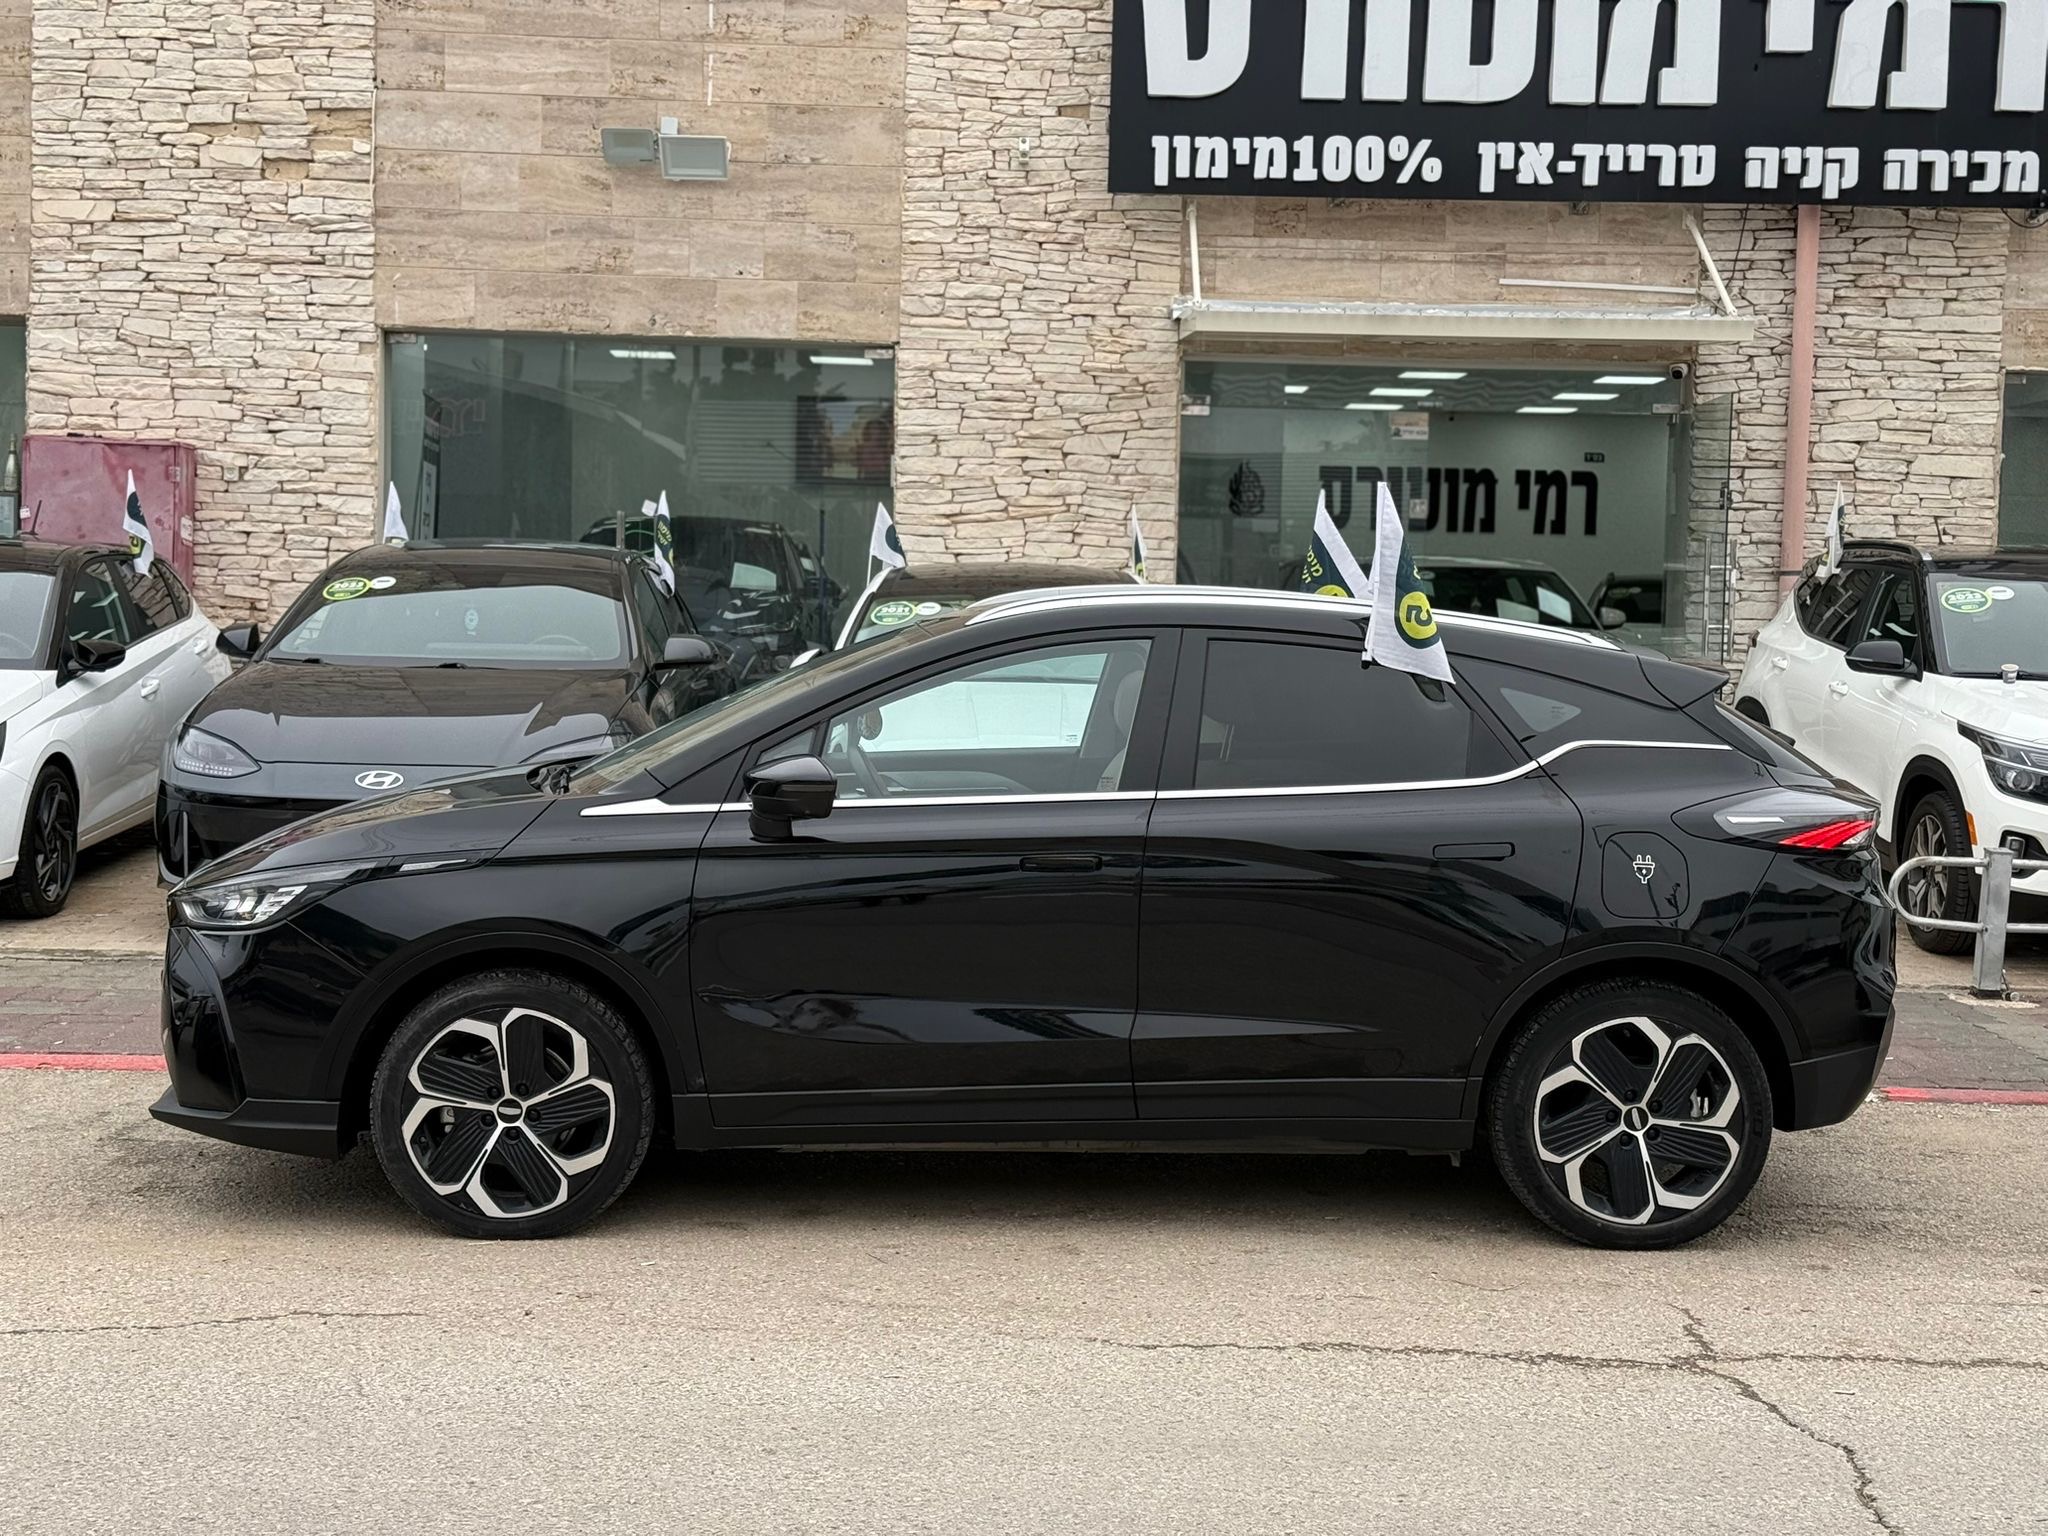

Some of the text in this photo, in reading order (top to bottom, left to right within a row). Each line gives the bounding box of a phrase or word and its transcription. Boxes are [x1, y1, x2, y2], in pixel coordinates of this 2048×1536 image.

[1477, 142, 1717, 193] טרייד-אין
[1744, 146, 1860, 200] קניה
[1883, 148, 2040, 193] מכירה
[1515, 469, 1599, 536] רמי
